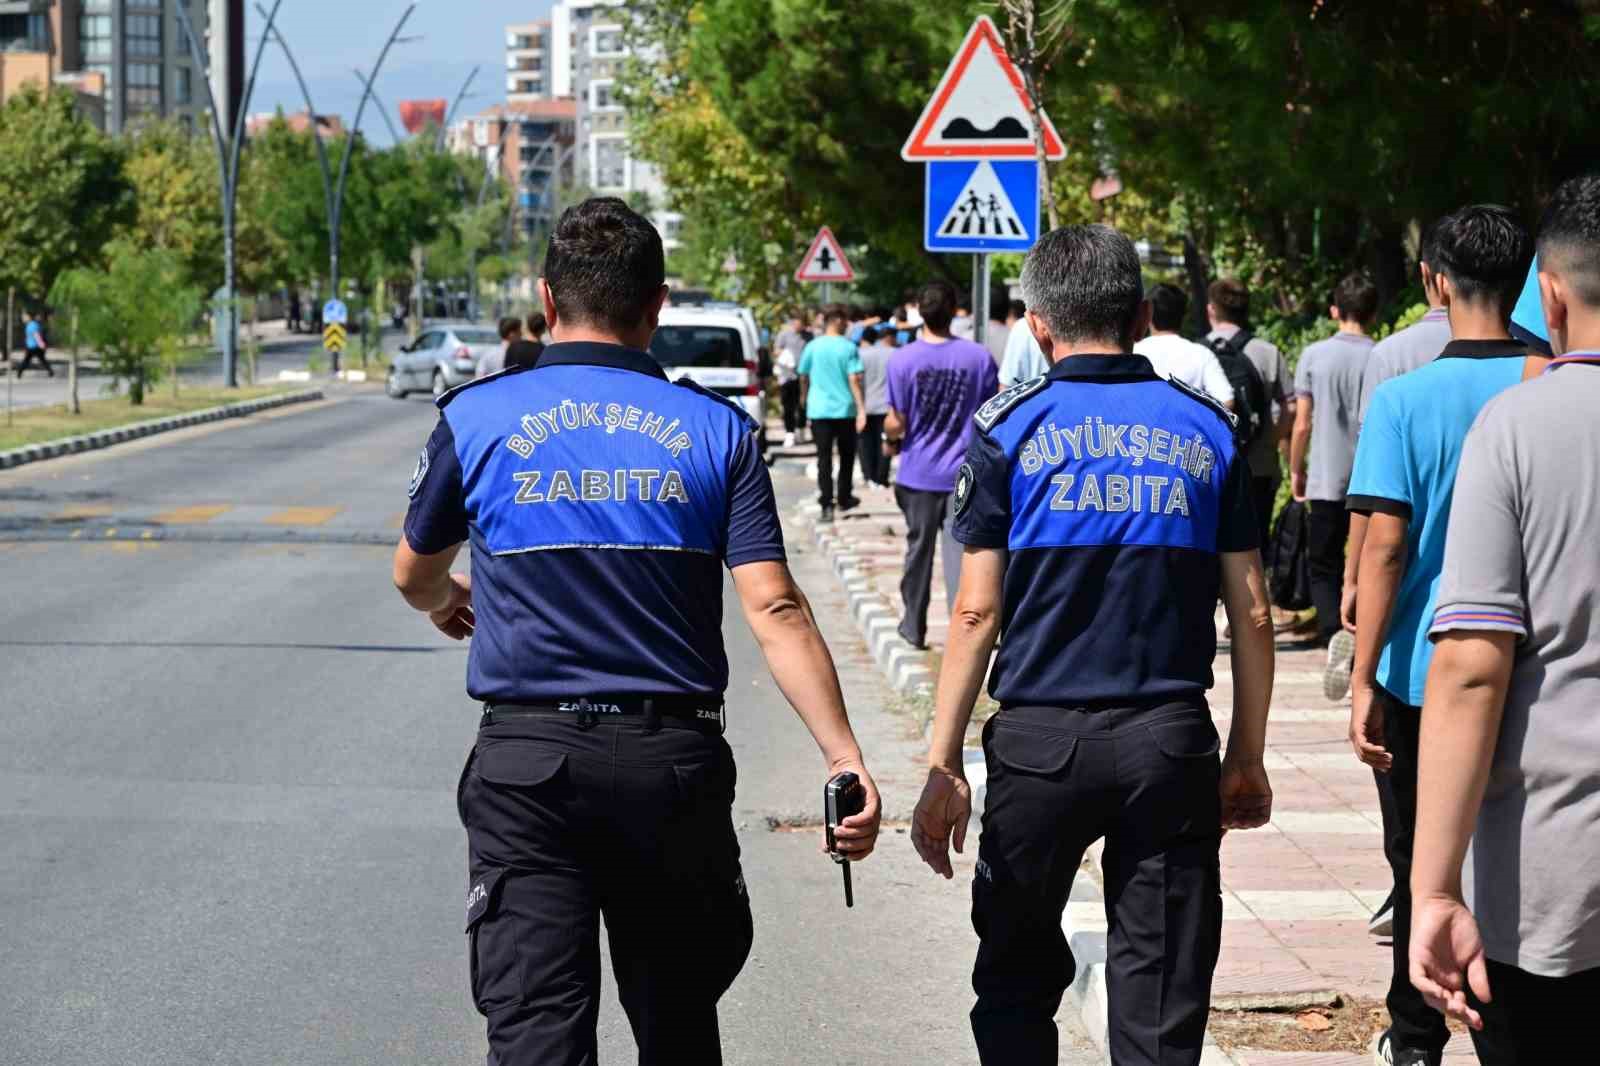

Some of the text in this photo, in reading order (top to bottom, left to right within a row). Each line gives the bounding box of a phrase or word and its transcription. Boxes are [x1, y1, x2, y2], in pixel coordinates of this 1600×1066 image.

[506, 399, 692, 458] BÜYÜKŞEHİR
[1019, 416, 1216, 484] BÜYÜKŞEHİR
[513, 469, 688, 504] ZABITA
[1049, 474, 1191, 517] ZABITA
